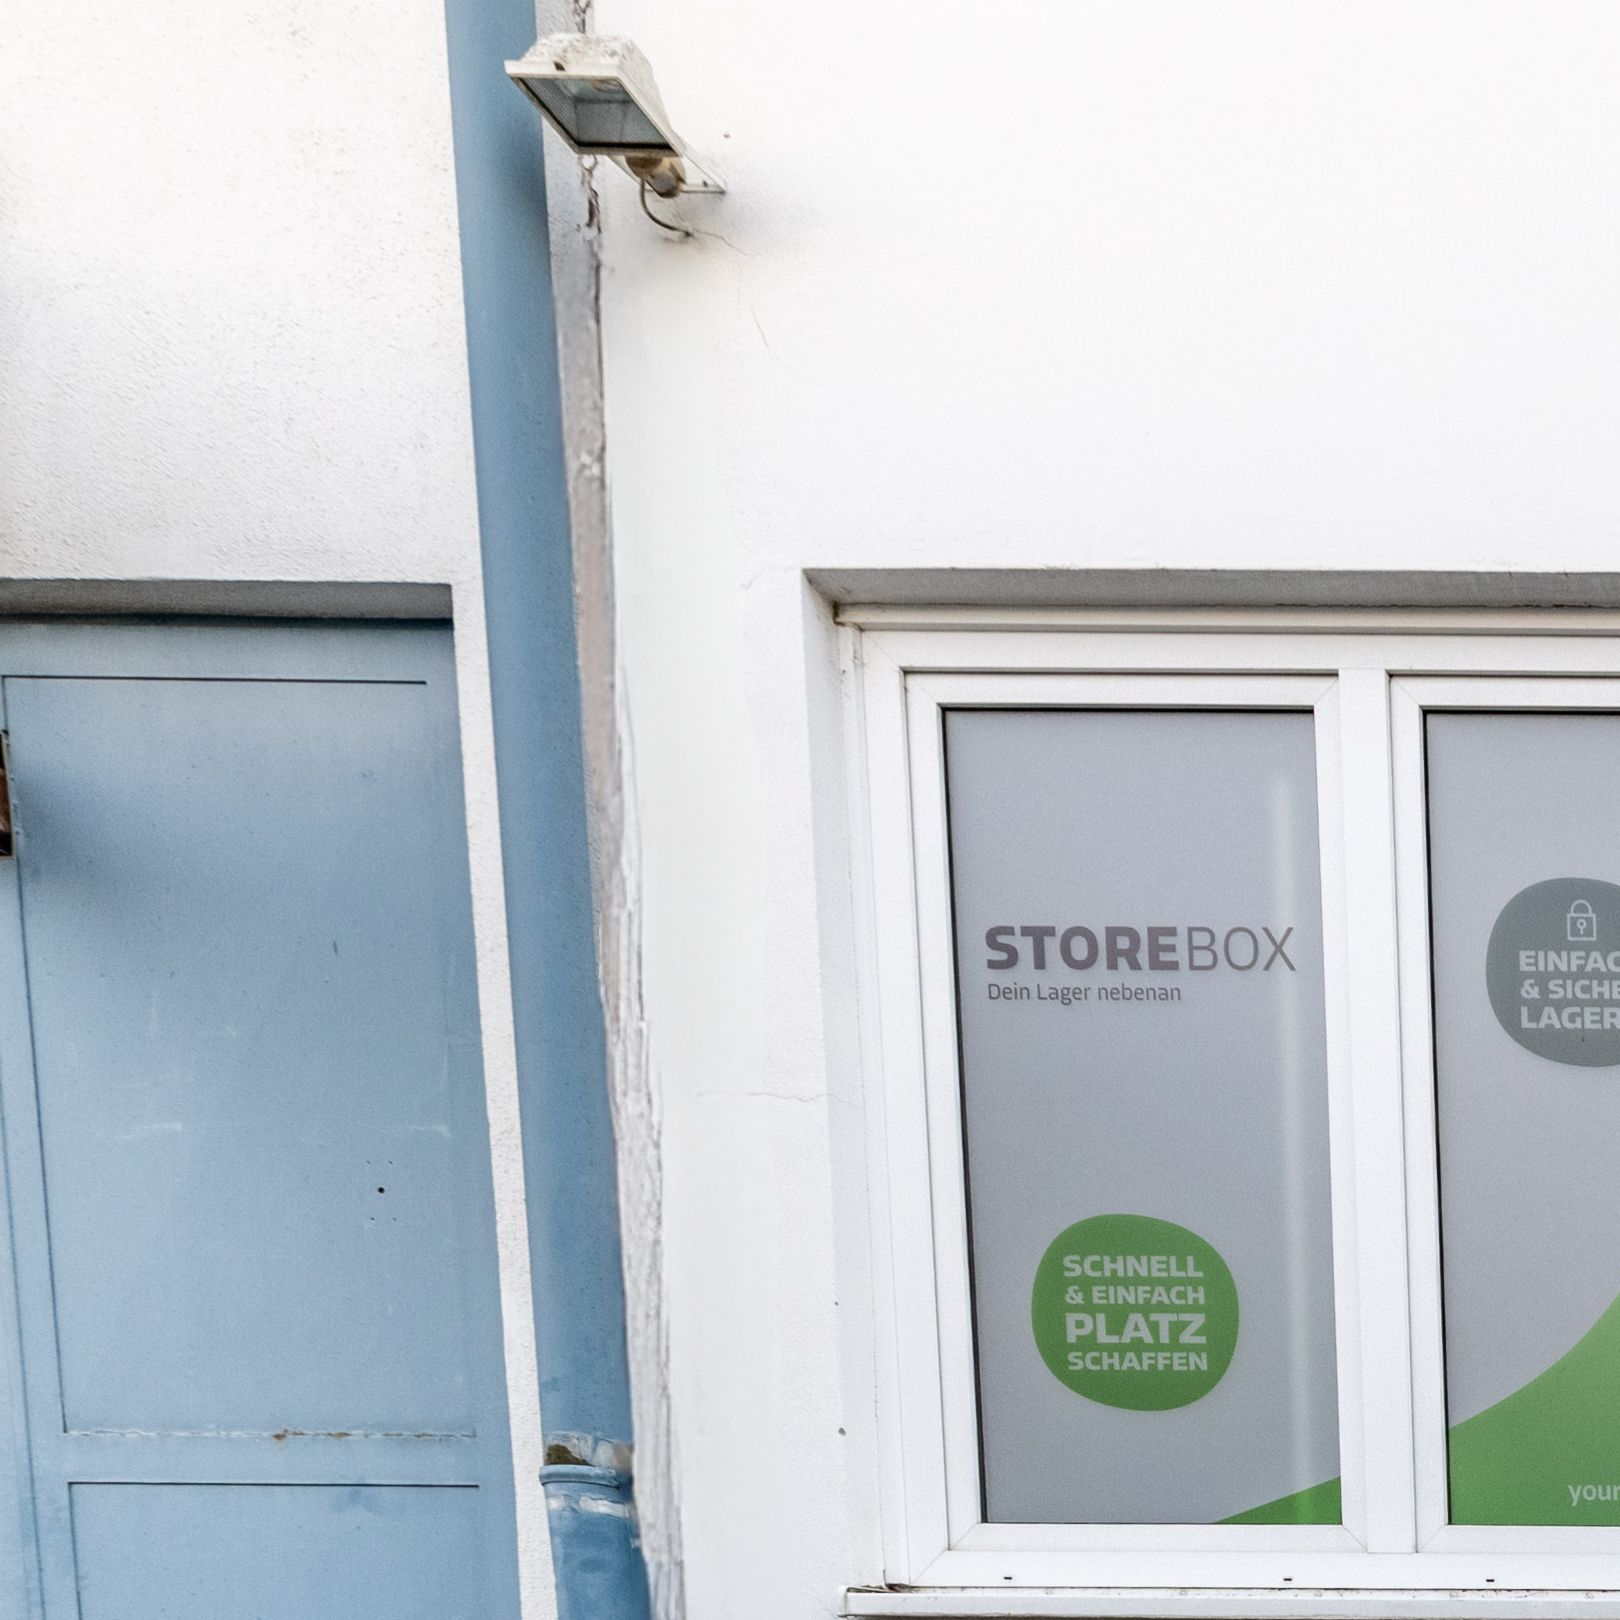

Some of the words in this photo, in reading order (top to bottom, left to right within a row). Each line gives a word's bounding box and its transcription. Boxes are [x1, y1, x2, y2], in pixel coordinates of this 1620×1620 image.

[984, 925, 1296, 972] STOREBOX
[987, 983, 1031, 1001] Dein
[1036, 983, 1092, 1006] Lager
[1097, 982, 1181, 1002] nebenan
[1520, 978, 1541, 999] &
[1063, 1254, 1204, 1278] SCHNELL
[1064, 1285, 1085, 1305] &
[1091, 1285, 1205, 1305] EINFACH
[1065, 1312, 1207, 1344] PLATZ
[1067, 1351, 1208, 1371] SCHAFFEN
